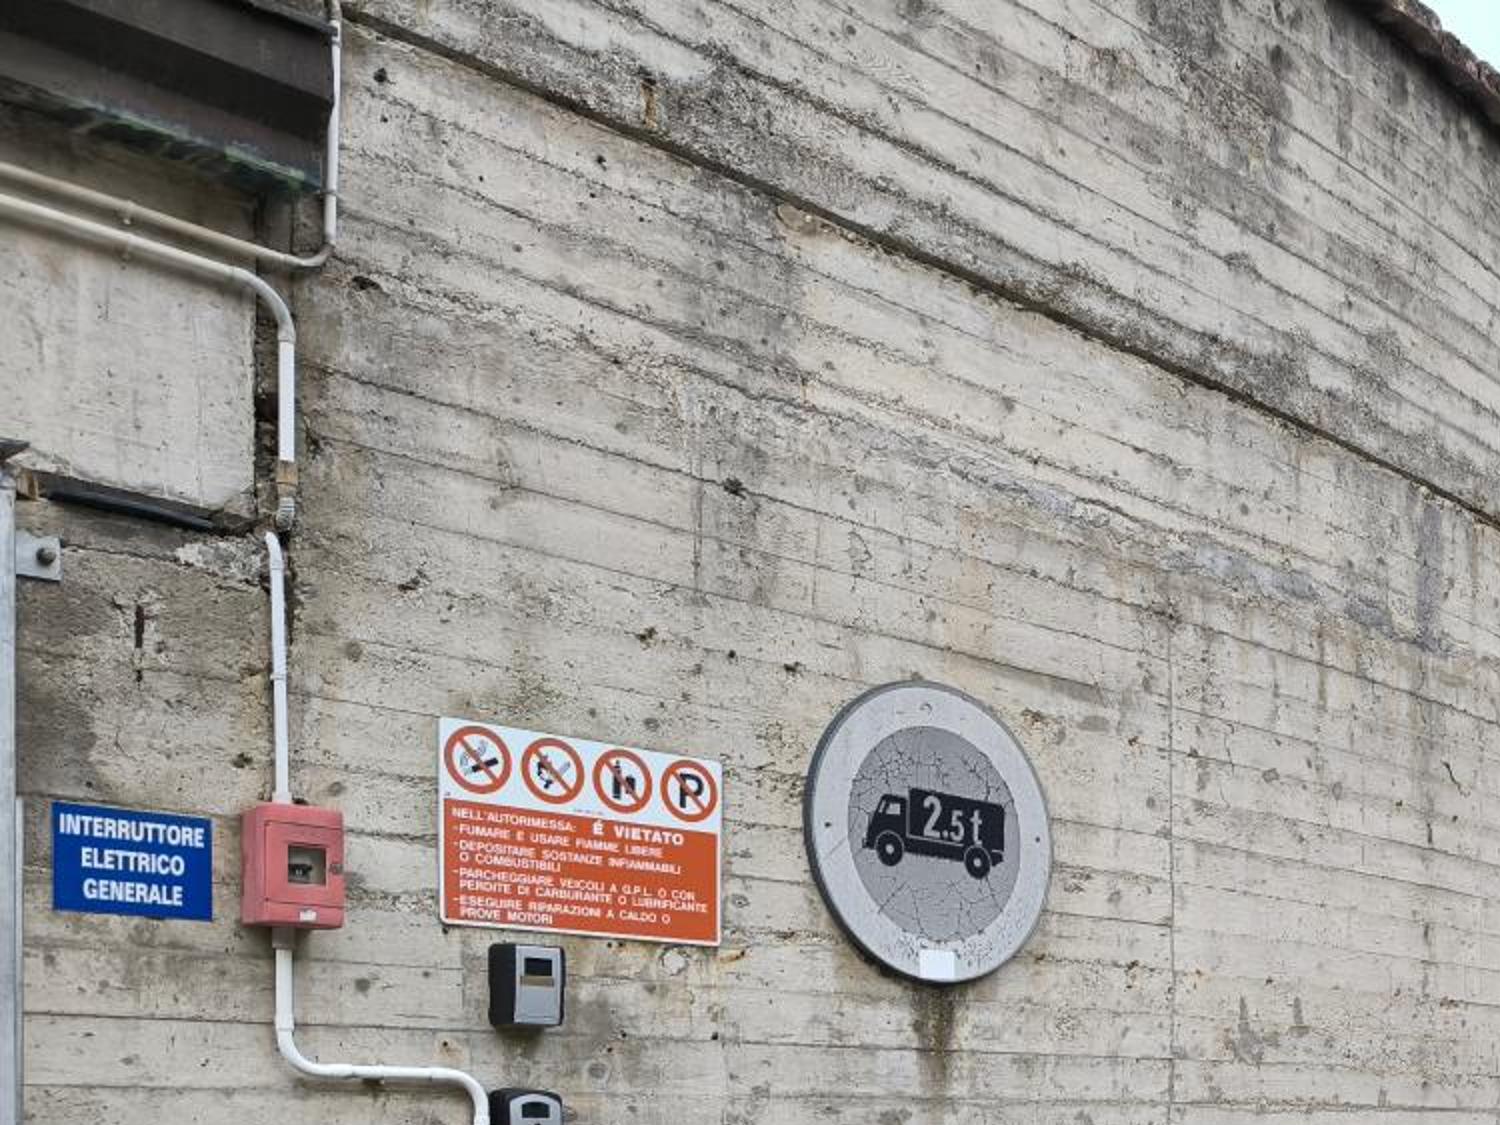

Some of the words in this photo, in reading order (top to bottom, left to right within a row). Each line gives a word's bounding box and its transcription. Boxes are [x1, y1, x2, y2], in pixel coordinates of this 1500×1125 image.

[59, 813, 205, 848] INTERRUTTORE
[451, 808, 577, 832] NELL'AUTORIMESSA:
[614, 825, 684, 846] VIETATO
[516, 830, 525, 841] E
[530, 835, 570, 847] USARE
[576, 838, 620, 853] FIAMME
[625, 844, 664, 858] LIBERE
[81, 847, 185, 876] ELETTRICO
[460, 852, 469, 862] O
[475, 852, 561, 873] COMBUSTIBILI
[542, 849, 603, 866] SOSTANZE
[608, 857, 681, 875] INFIAMMABILI
[83, 878, 183, 906] GENERALE
[460, 879, 512, 894] PERDITE
[517, 885, 530, 896] DI
[535, 887, 613, 905] CARBURANTE
[618, 895, 628, 905] O
[632, 896, 708, 914] LUBRIFICANTE
[560, 877, 605, 892] VEICOLI
[609, 882, 618, 893] A
[657, 887, 667, 899] O
[671, 889, 696, 902] CON
[460, 906, 501, 921] PROVE
[507, 911, 553, 925] MOTORI
[528, 901, 601, 918] RIPARAZIONI
[607, 908, 615, 919] A
[619, 909, 657, 923] CALDO
[661, 913, 671, 925] O
